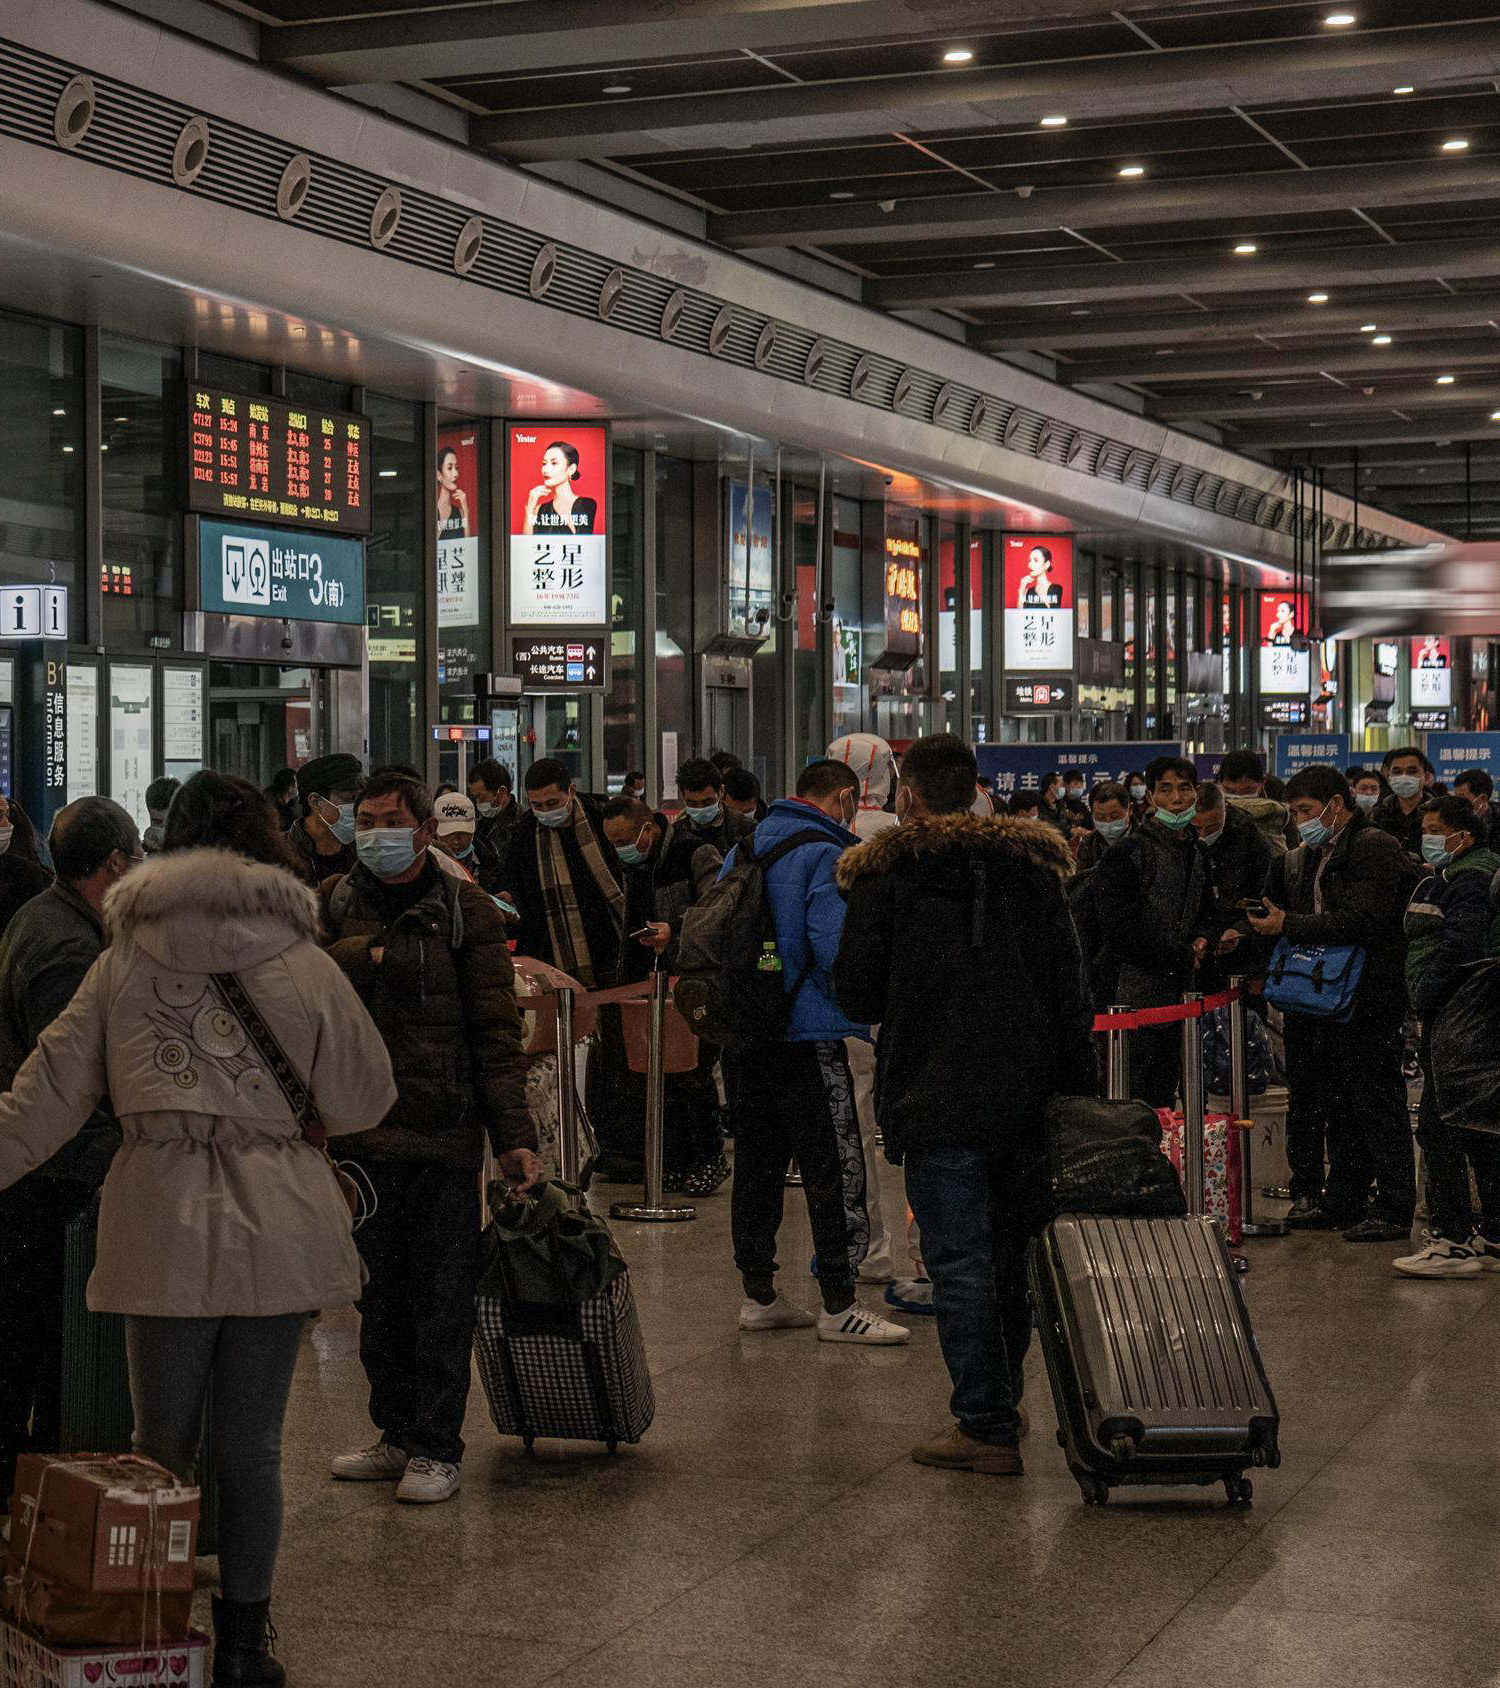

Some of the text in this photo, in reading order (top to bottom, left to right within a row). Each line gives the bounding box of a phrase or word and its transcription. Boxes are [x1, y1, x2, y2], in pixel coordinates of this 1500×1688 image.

[196, 392, 210, 410] 车次
[533, 544, 583, 566] 艺星
[532, 567, 584, 590] 整形
[272, 584, 288, 602] Exit
[530, 644, 564, 656] 公共汽车
[47, 661, 64, 687] B1
[530, 664, 564, 675] 长途汽车
[53, 692, 66, 787] 信息服务
[1057, 753, 1099, 764] 温馨提示
[1287, 743, 1339, 757] 温馨提示
[1438, 747, 1491, 760] 温馨提示
